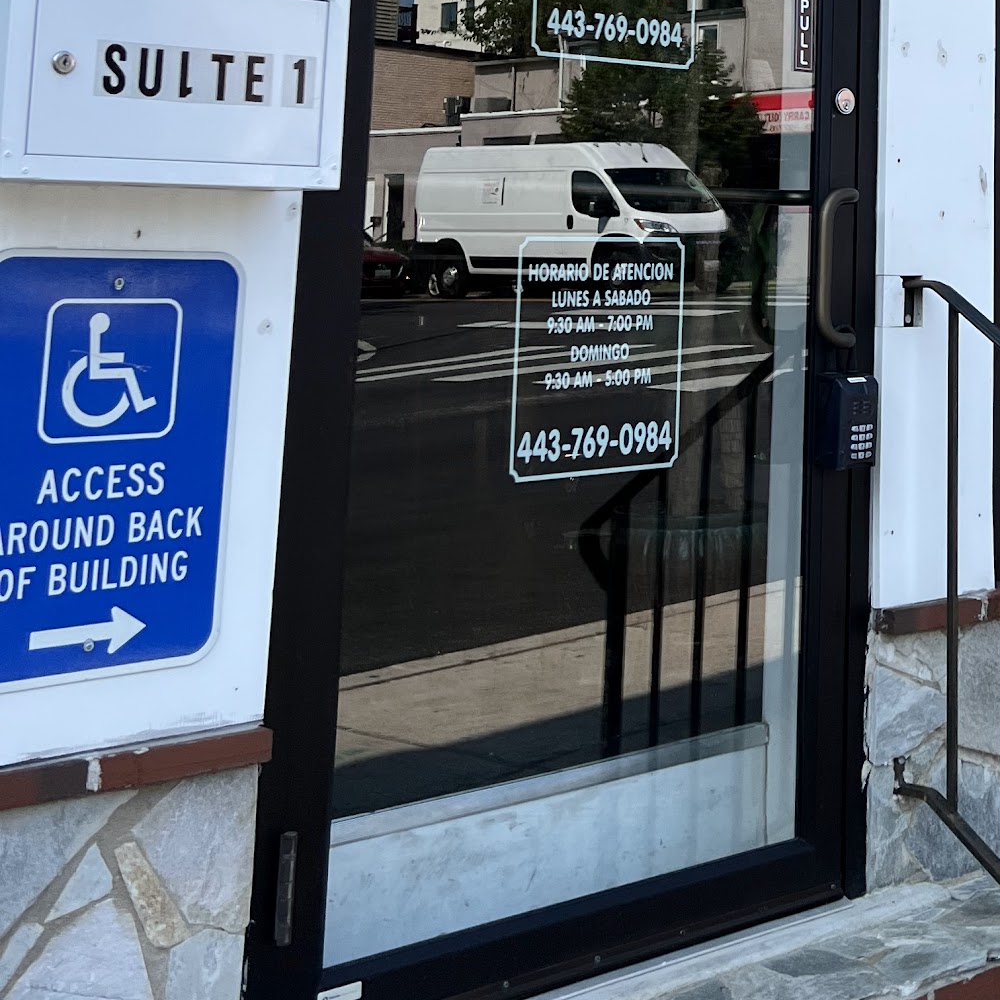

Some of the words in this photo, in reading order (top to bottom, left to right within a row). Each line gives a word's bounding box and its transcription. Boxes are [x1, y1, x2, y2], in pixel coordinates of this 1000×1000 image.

[547, 7, 683, 48] 443-769-0984
[103, 43, 265, 103] SUITE
[294, 59, 306, 104] 1
[528, 263, 589, 282] HORARIO
[593, 263, 610, 281] DE
[612, 262, 674, 281] ATENCION
[552, 290, 590, 308] LUNES
[592, 290, 601, 307] A
[604, 289, 651, 307] SABADO
[547, 317, 573, 334] 9:30
[576, 316, 595, 333] AM
[607, 315, 633, 332] 7:00
[635, 315, 653, 331] PM
[570, 343, 630, 362] DOMINGO
[544, 372, 570, 390] 9:30
[573, 371, 593, 388] AM
[605, 369, 630, 387] 5:00
[633, 368, 652, 385] PM
[517, 420, 673, 464] 443-769-0984
[36, 461, 166, 505] ACCESS
[0, 514, 115, 556] ROUND
[128, 506, 203, 543] BACK
[0, 566, 36, 601] OF
[48, 550, 189, 596] BUILDING
